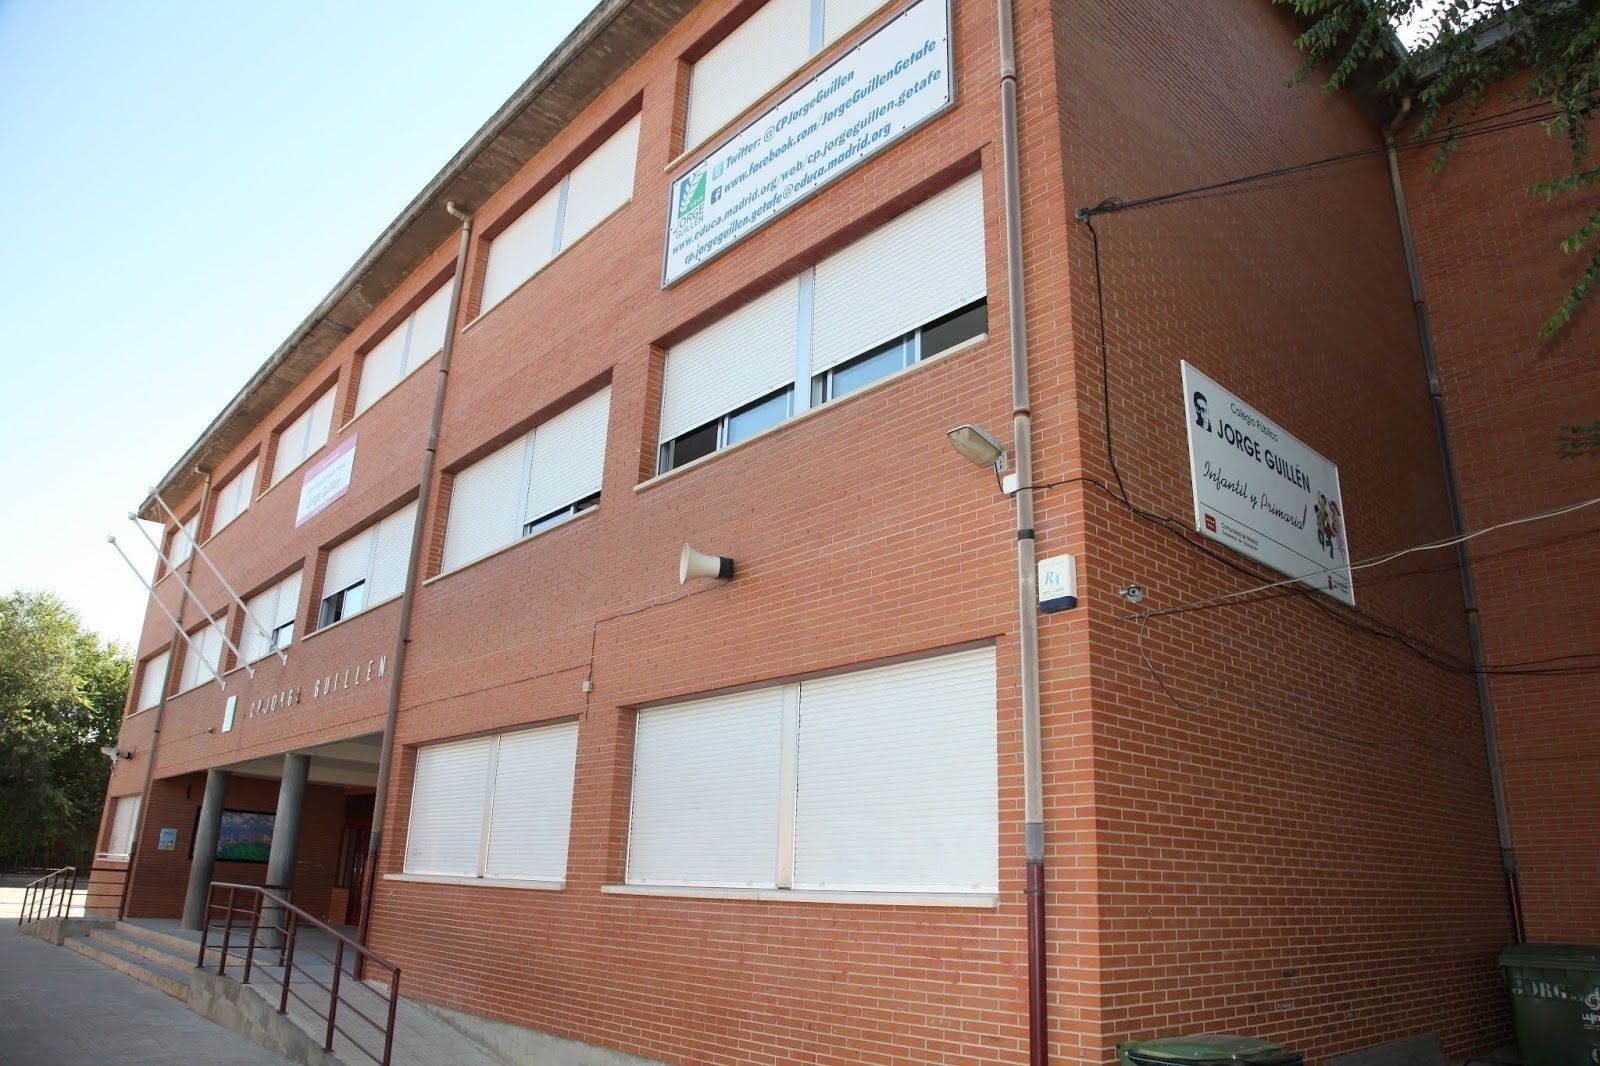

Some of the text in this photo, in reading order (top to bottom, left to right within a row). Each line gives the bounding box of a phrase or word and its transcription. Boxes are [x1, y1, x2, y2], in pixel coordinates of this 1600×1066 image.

[724, 40, 936, 193] www.facebook.com/JorgeGuillenGetafe
[726, 70, 854, 168] Twitter: @CPJorgeGuillen
[685, 123, 891, 264] cp.jorgeguillen.getafe@educa.madrid.org
[1230, 402, 1255, 426] Colegio
[1203, 460, 1247, 498] Infantil
[1250, 493, 1258, 509] y
[1217, 419, 1310, 493] JORGE GUILLÉN
[314, 655, 386, 698] GUILLEN
